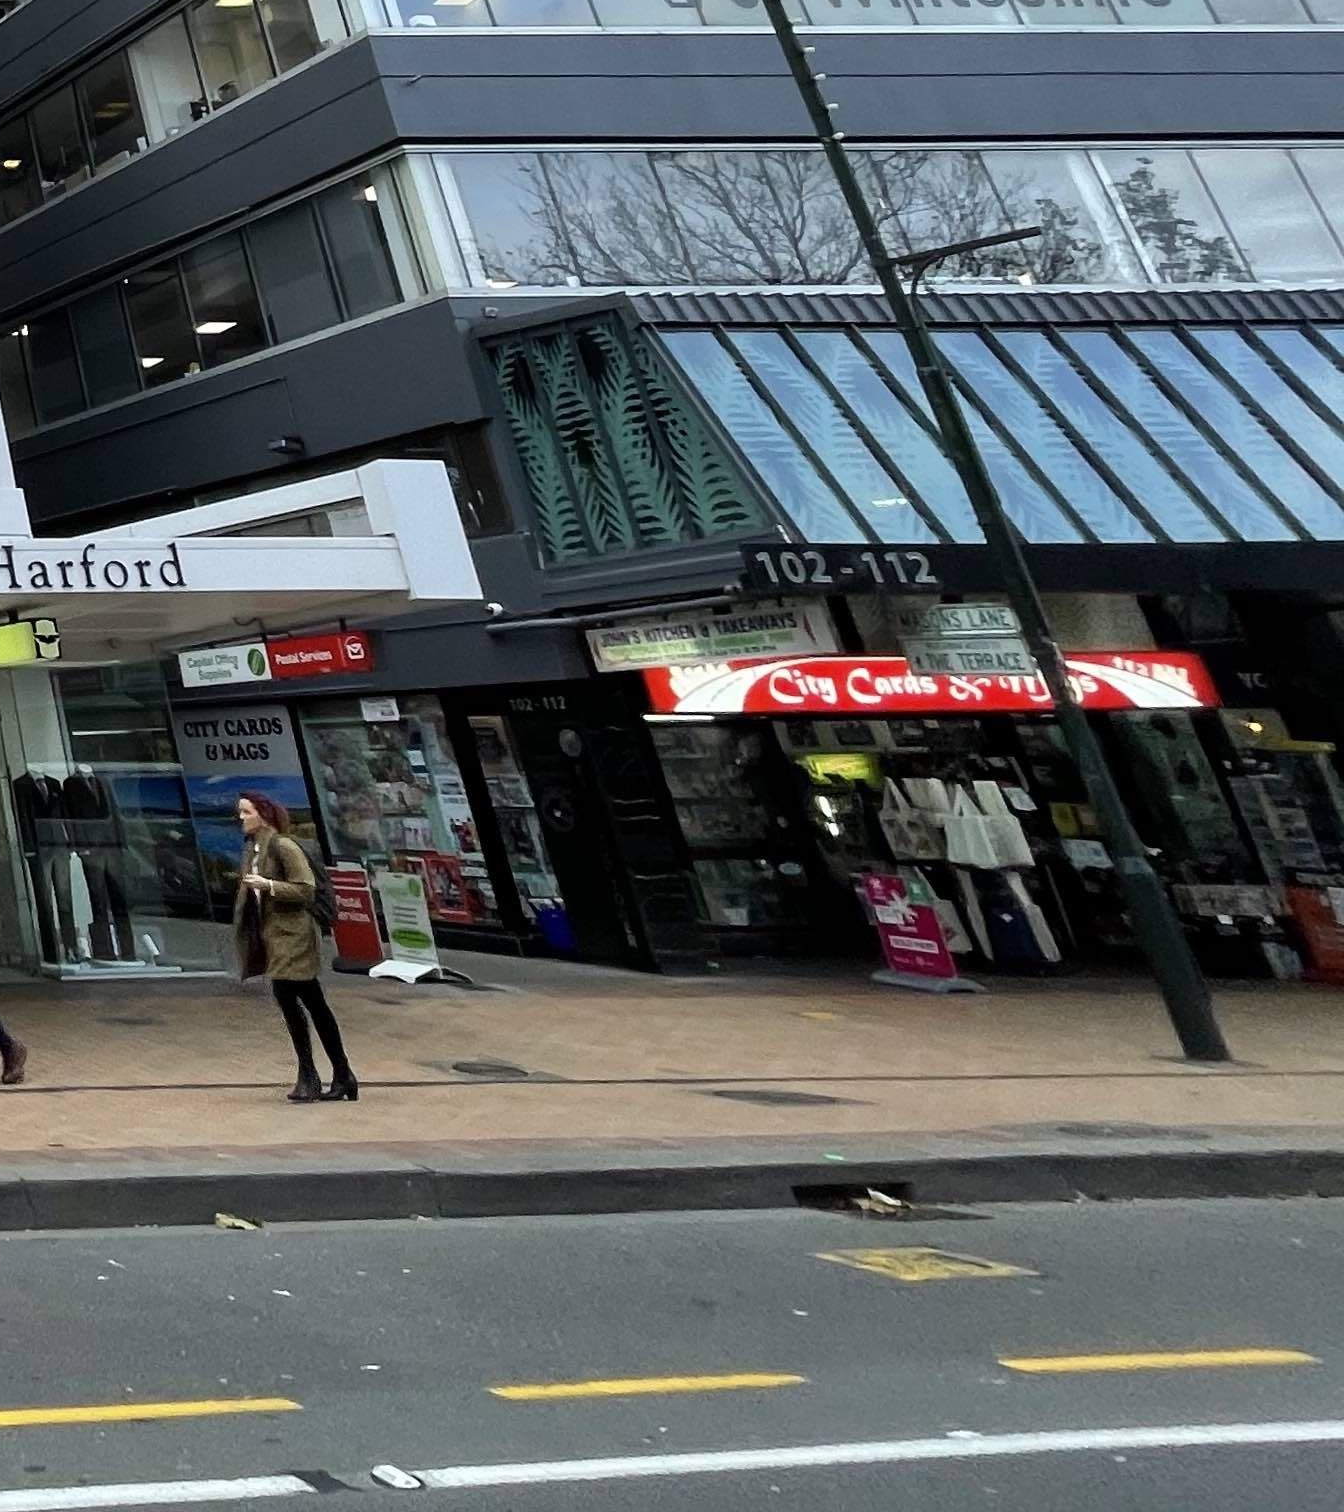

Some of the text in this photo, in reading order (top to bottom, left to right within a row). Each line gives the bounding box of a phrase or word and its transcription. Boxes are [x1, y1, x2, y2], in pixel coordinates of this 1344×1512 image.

[643, 624, 697, 644] KITCHEN
[713, 612, 798, 635] TAKEAWAYS
[965, 608, 1011, 628] LANE
[955, 652, 1026, 671] TERRACE
[769, 667, 838, 705] City
[847, 668, 939, 704] Cards
[183, 716, 284, 738] CITY CARDS
[220, 742, 270, 761] MAGS
